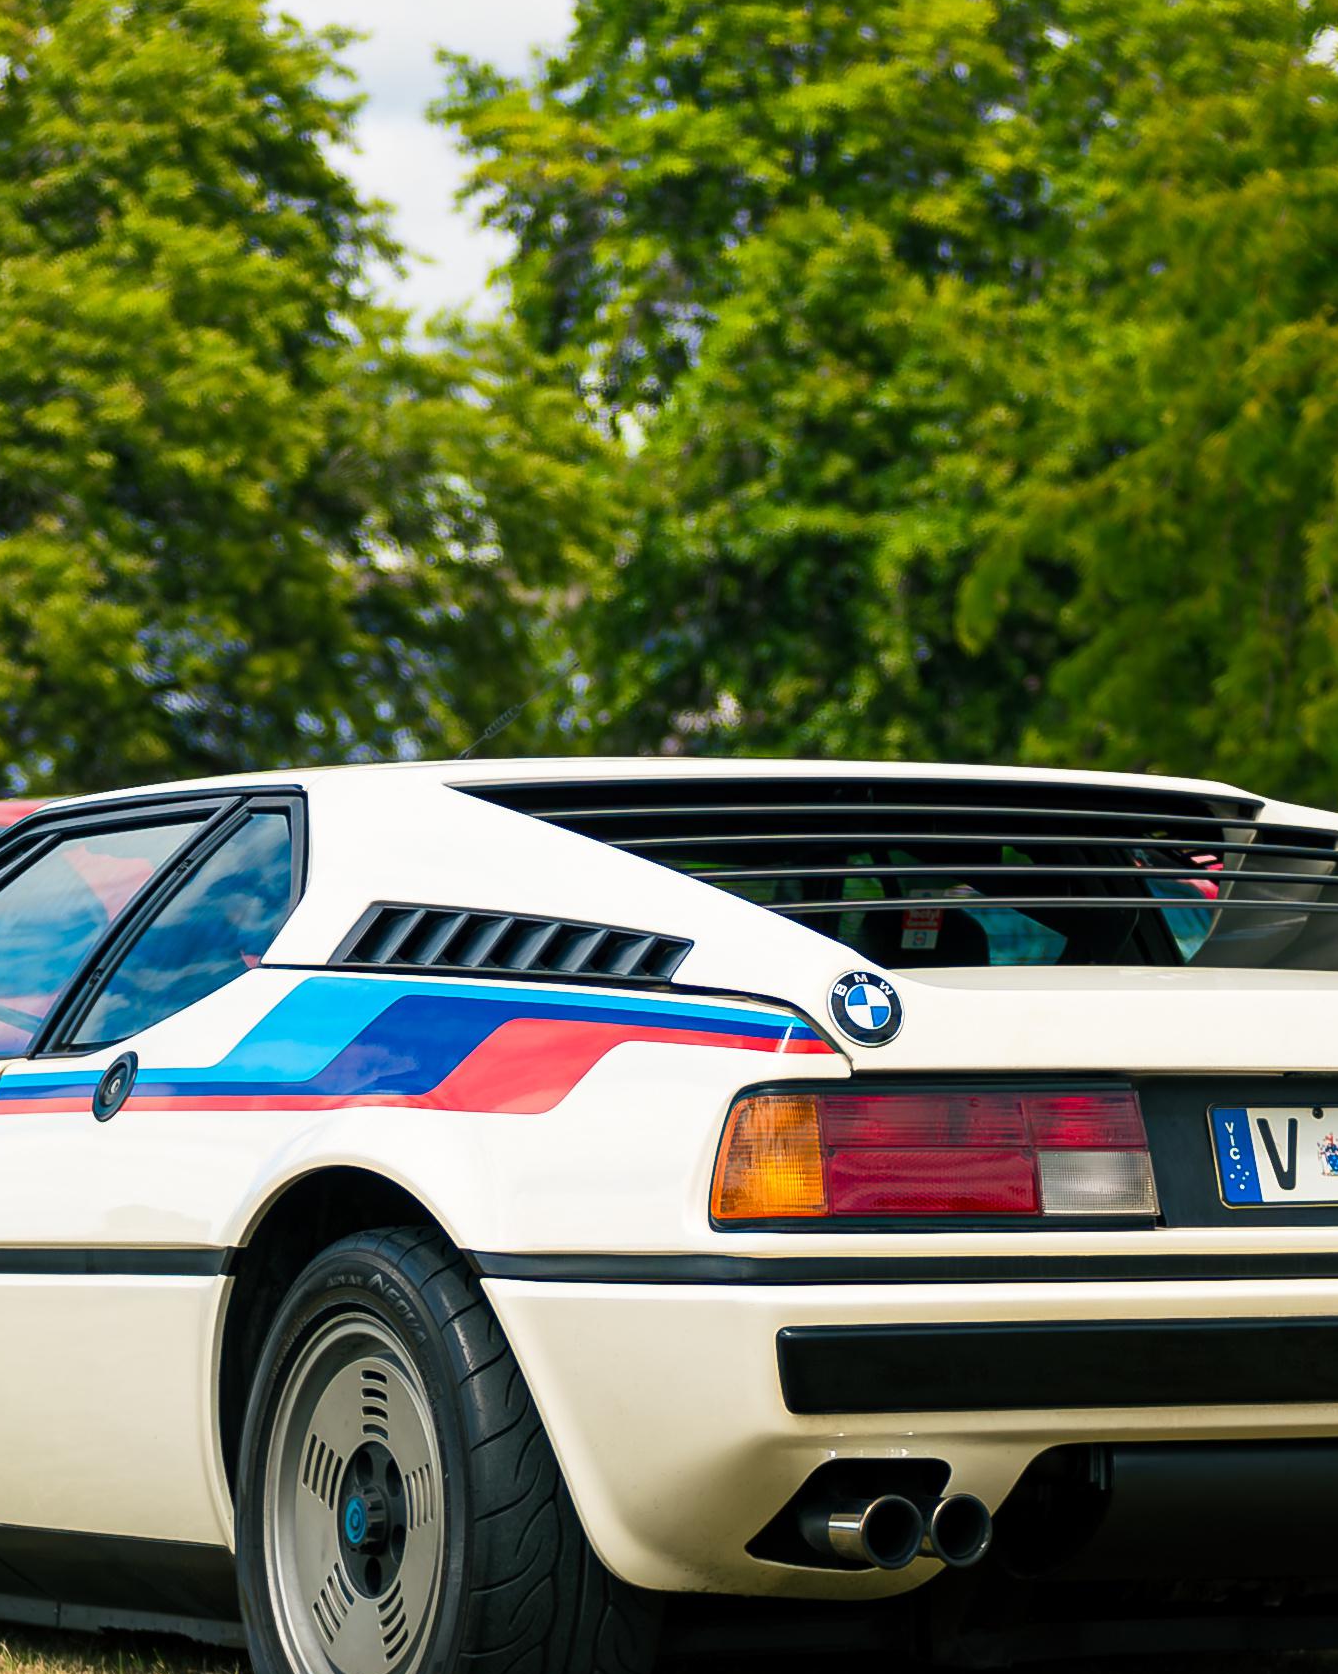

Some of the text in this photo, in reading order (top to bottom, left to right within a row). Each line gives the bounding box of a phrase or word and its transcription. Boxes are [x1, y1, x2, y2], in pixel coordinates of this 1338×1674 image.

[834, 973, 894, 997] BMW
[1224, 1121, 1241, 1160] VIC
[1256, 1117, 1299, 1191] V
